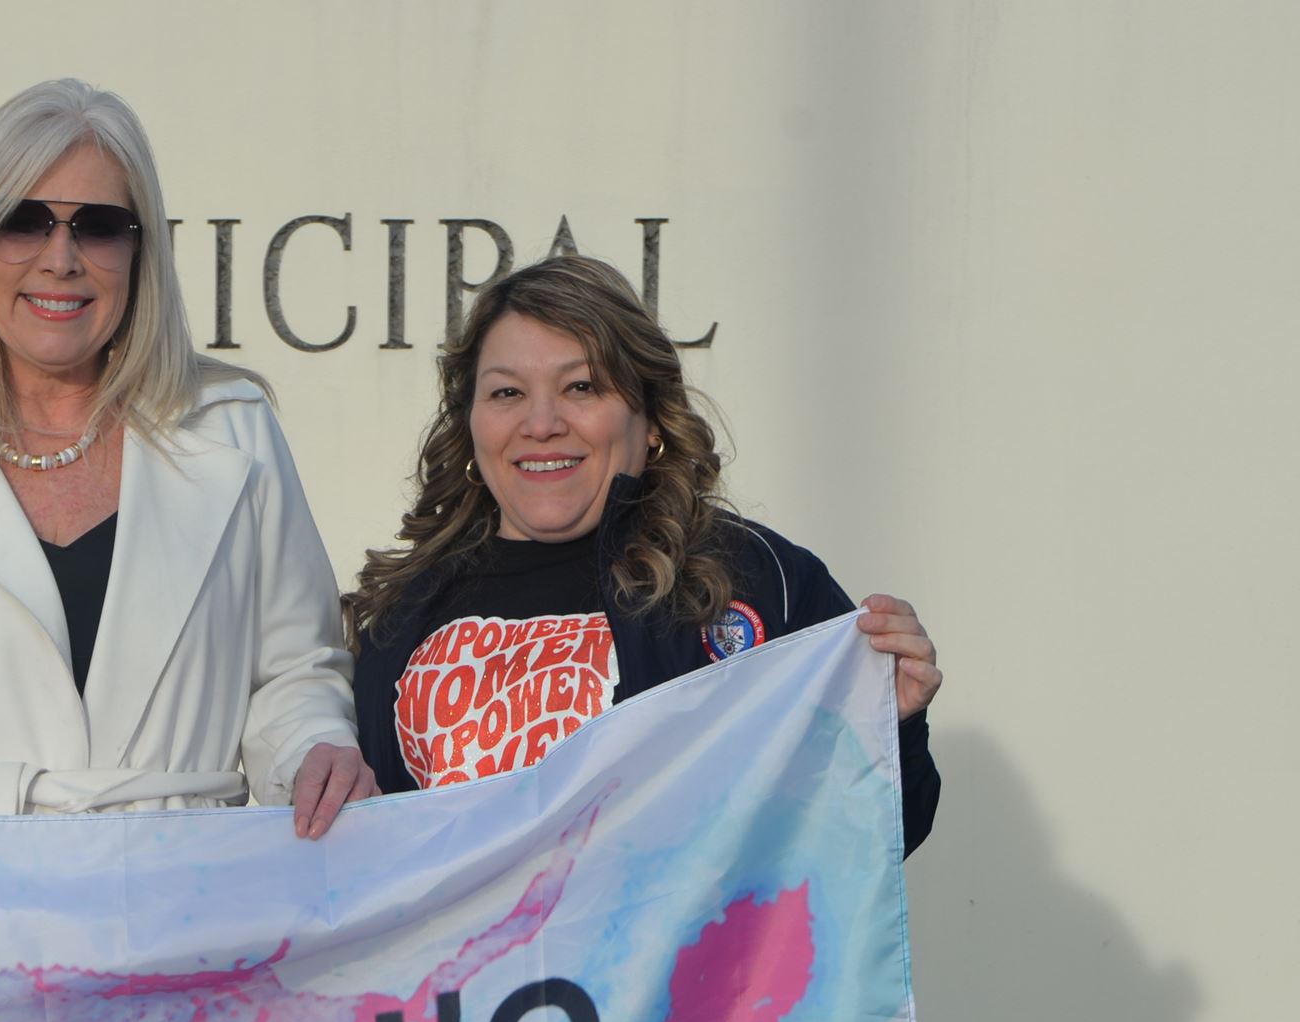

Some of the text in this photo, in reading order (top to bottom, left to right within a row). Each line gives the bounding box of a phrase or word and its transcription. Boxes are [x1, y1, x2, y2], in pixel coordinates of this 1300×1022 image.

[397, 630, 614, 734] WOMEN
[409, 615, 610, 665] EMPOWERE
[397, 665, 604, 774] EMPOWER
